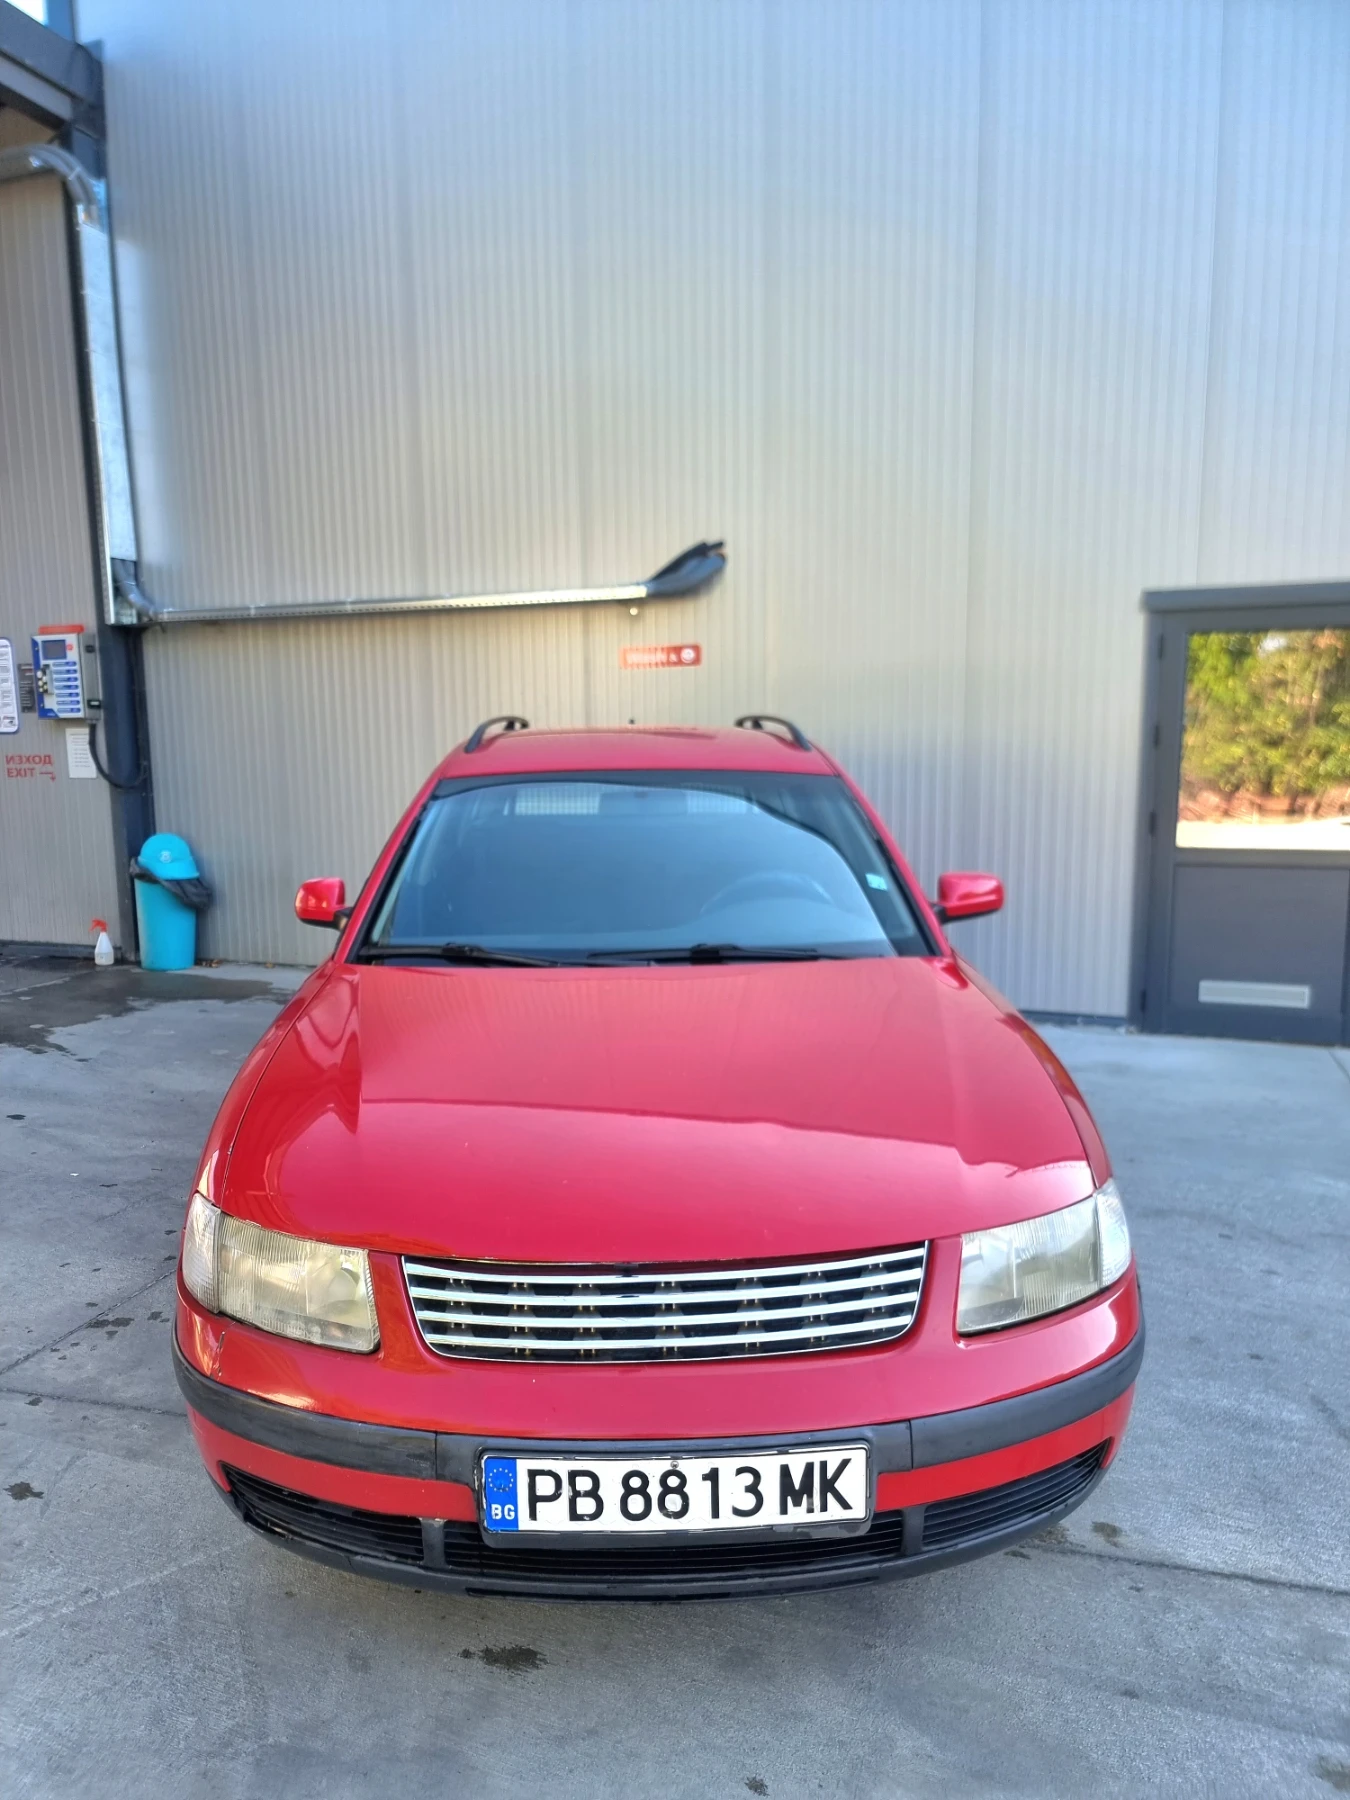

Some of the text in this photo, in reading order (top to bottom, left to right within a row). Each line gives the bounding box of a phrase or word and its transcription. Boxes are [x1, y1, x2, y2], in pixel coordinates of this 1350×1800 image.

[6, 755, 52, 766] ИЗХОД
[7, 768, 36, 778] EXIT
[527, 1458, 852, 1522] PB 8813 MK
[491, 1504, 515, 1520] BG
